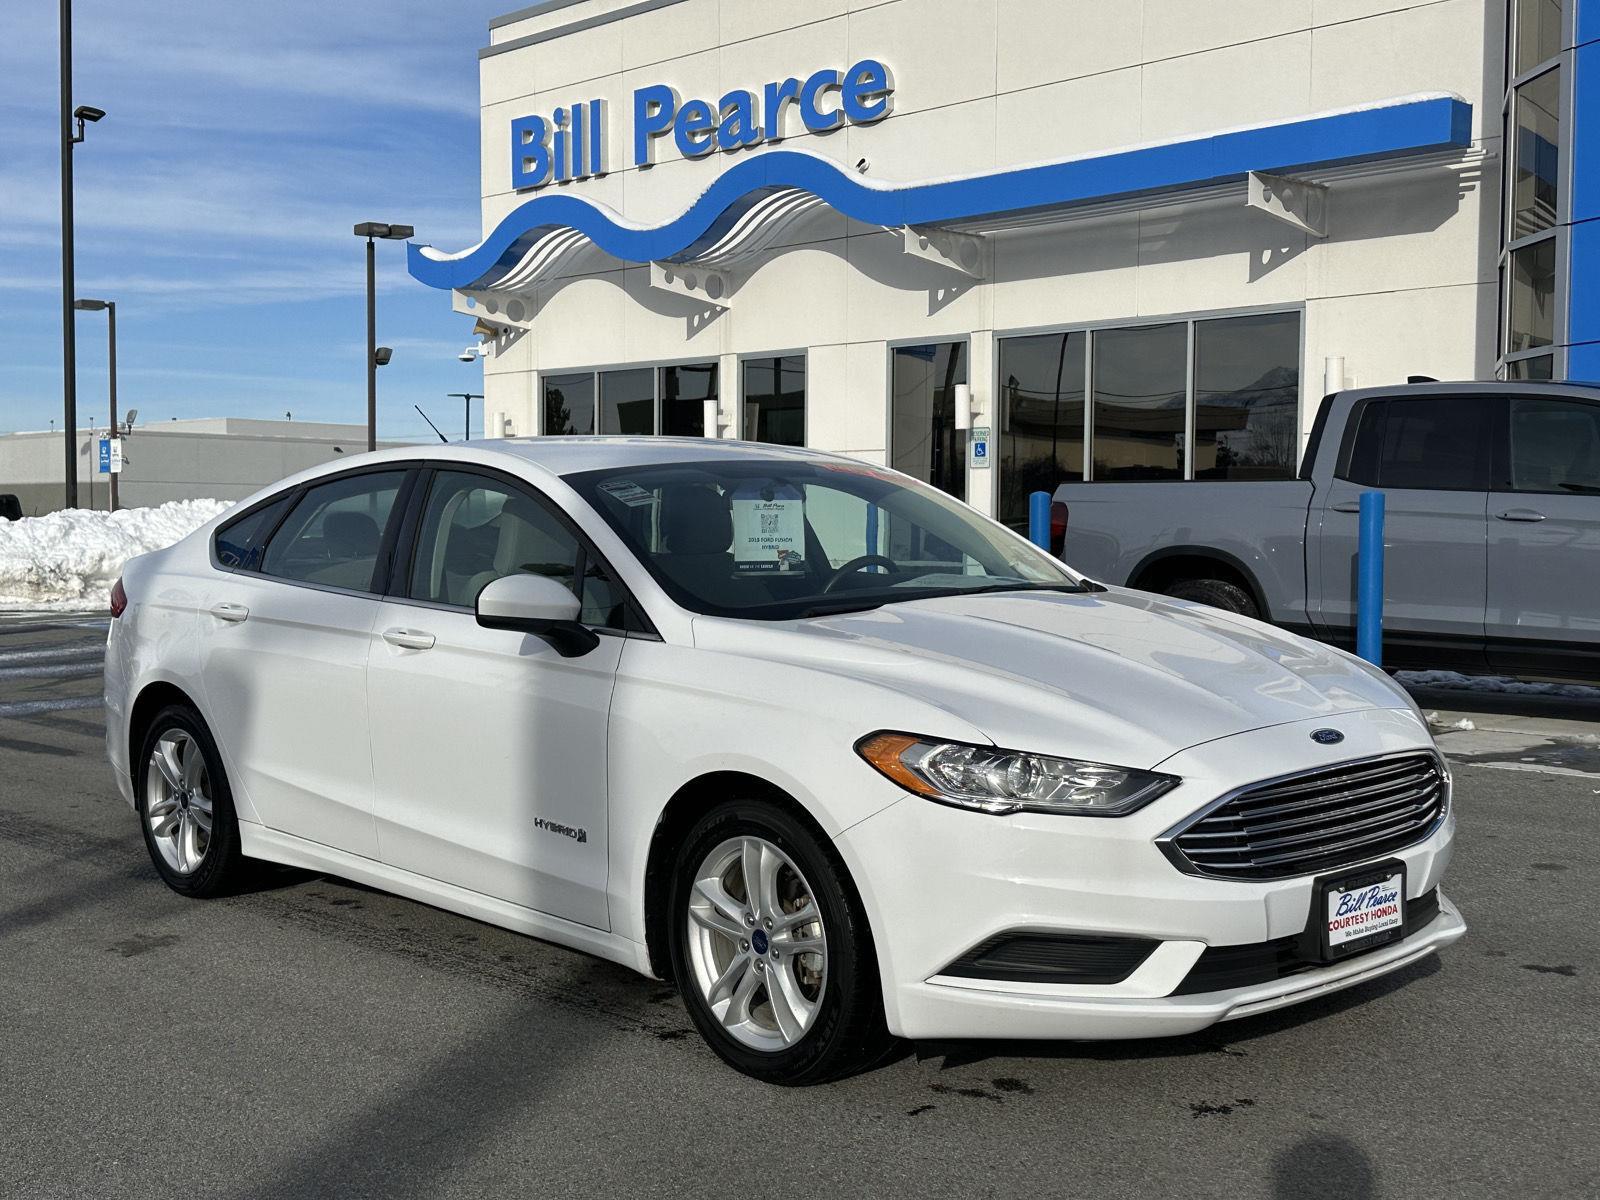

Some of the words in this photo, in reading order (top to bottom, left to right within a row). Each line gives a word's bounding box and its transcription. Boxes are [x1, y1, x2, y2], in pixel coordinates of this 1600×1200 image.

[511, 98, 607, 192] Bill
[634, 59, 895, 168] Pearce
[534, 817, 577, 839] HYBRID
[1336, 891, 1367, 917] Bill
[1366, 886, 1398, 909] Pearce
[1328, 911, 1370, 932] COURTESY
[1371, 904, 1398, 920] HONDA
